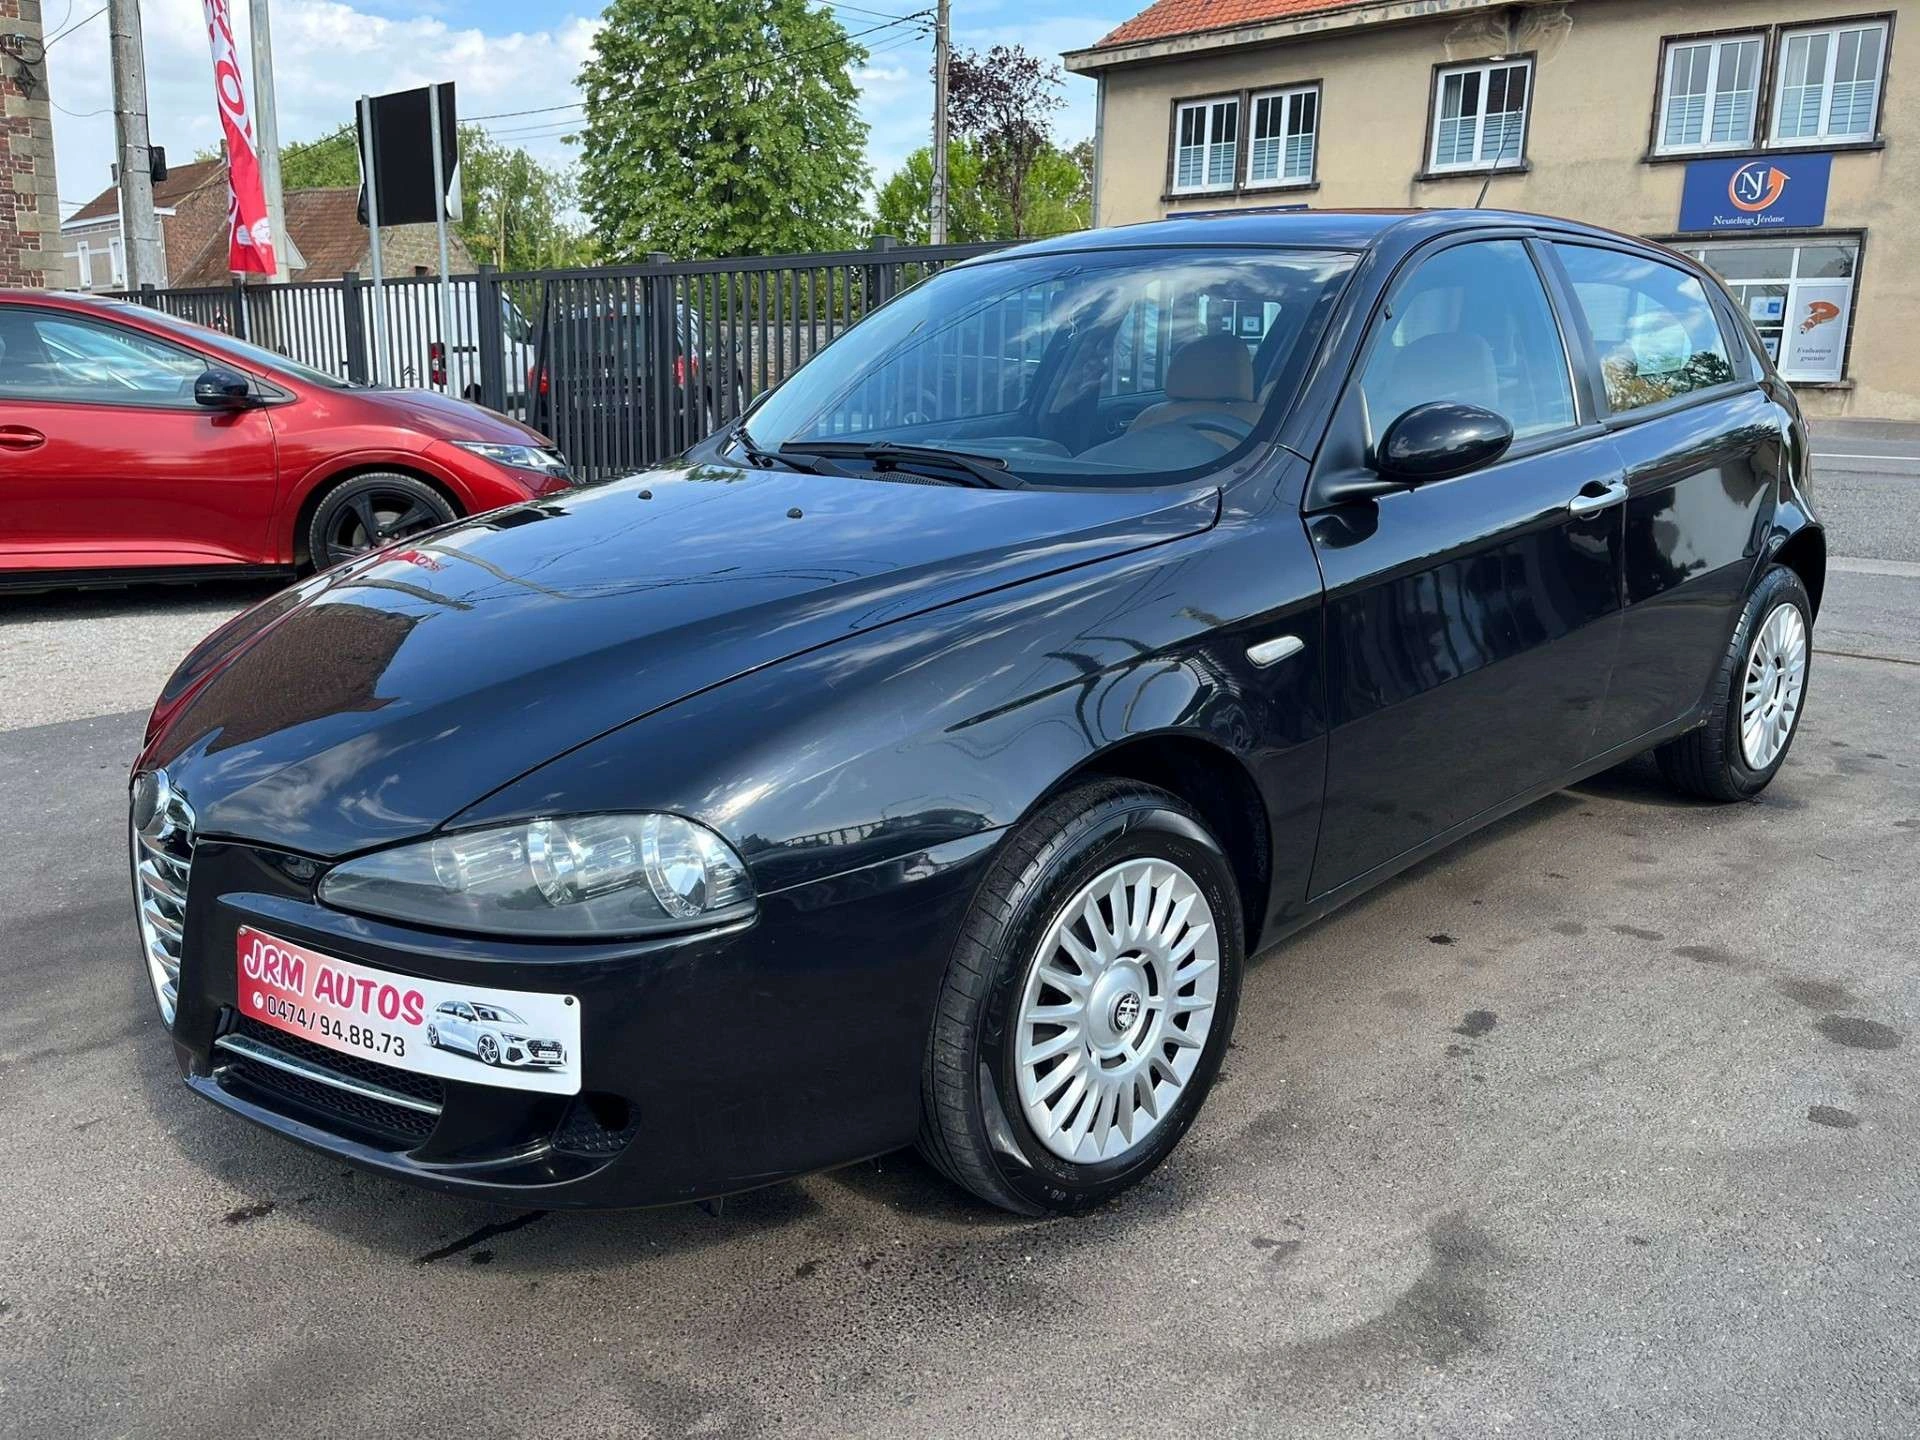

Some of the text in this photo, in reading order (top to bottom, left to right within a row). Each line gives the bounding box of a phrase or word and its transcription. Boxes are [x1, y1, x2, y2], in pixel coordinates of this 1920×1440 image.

[1738, 170, 1767, 200] NJ
[244, 939, 425, 1026] JRM AUTOS
